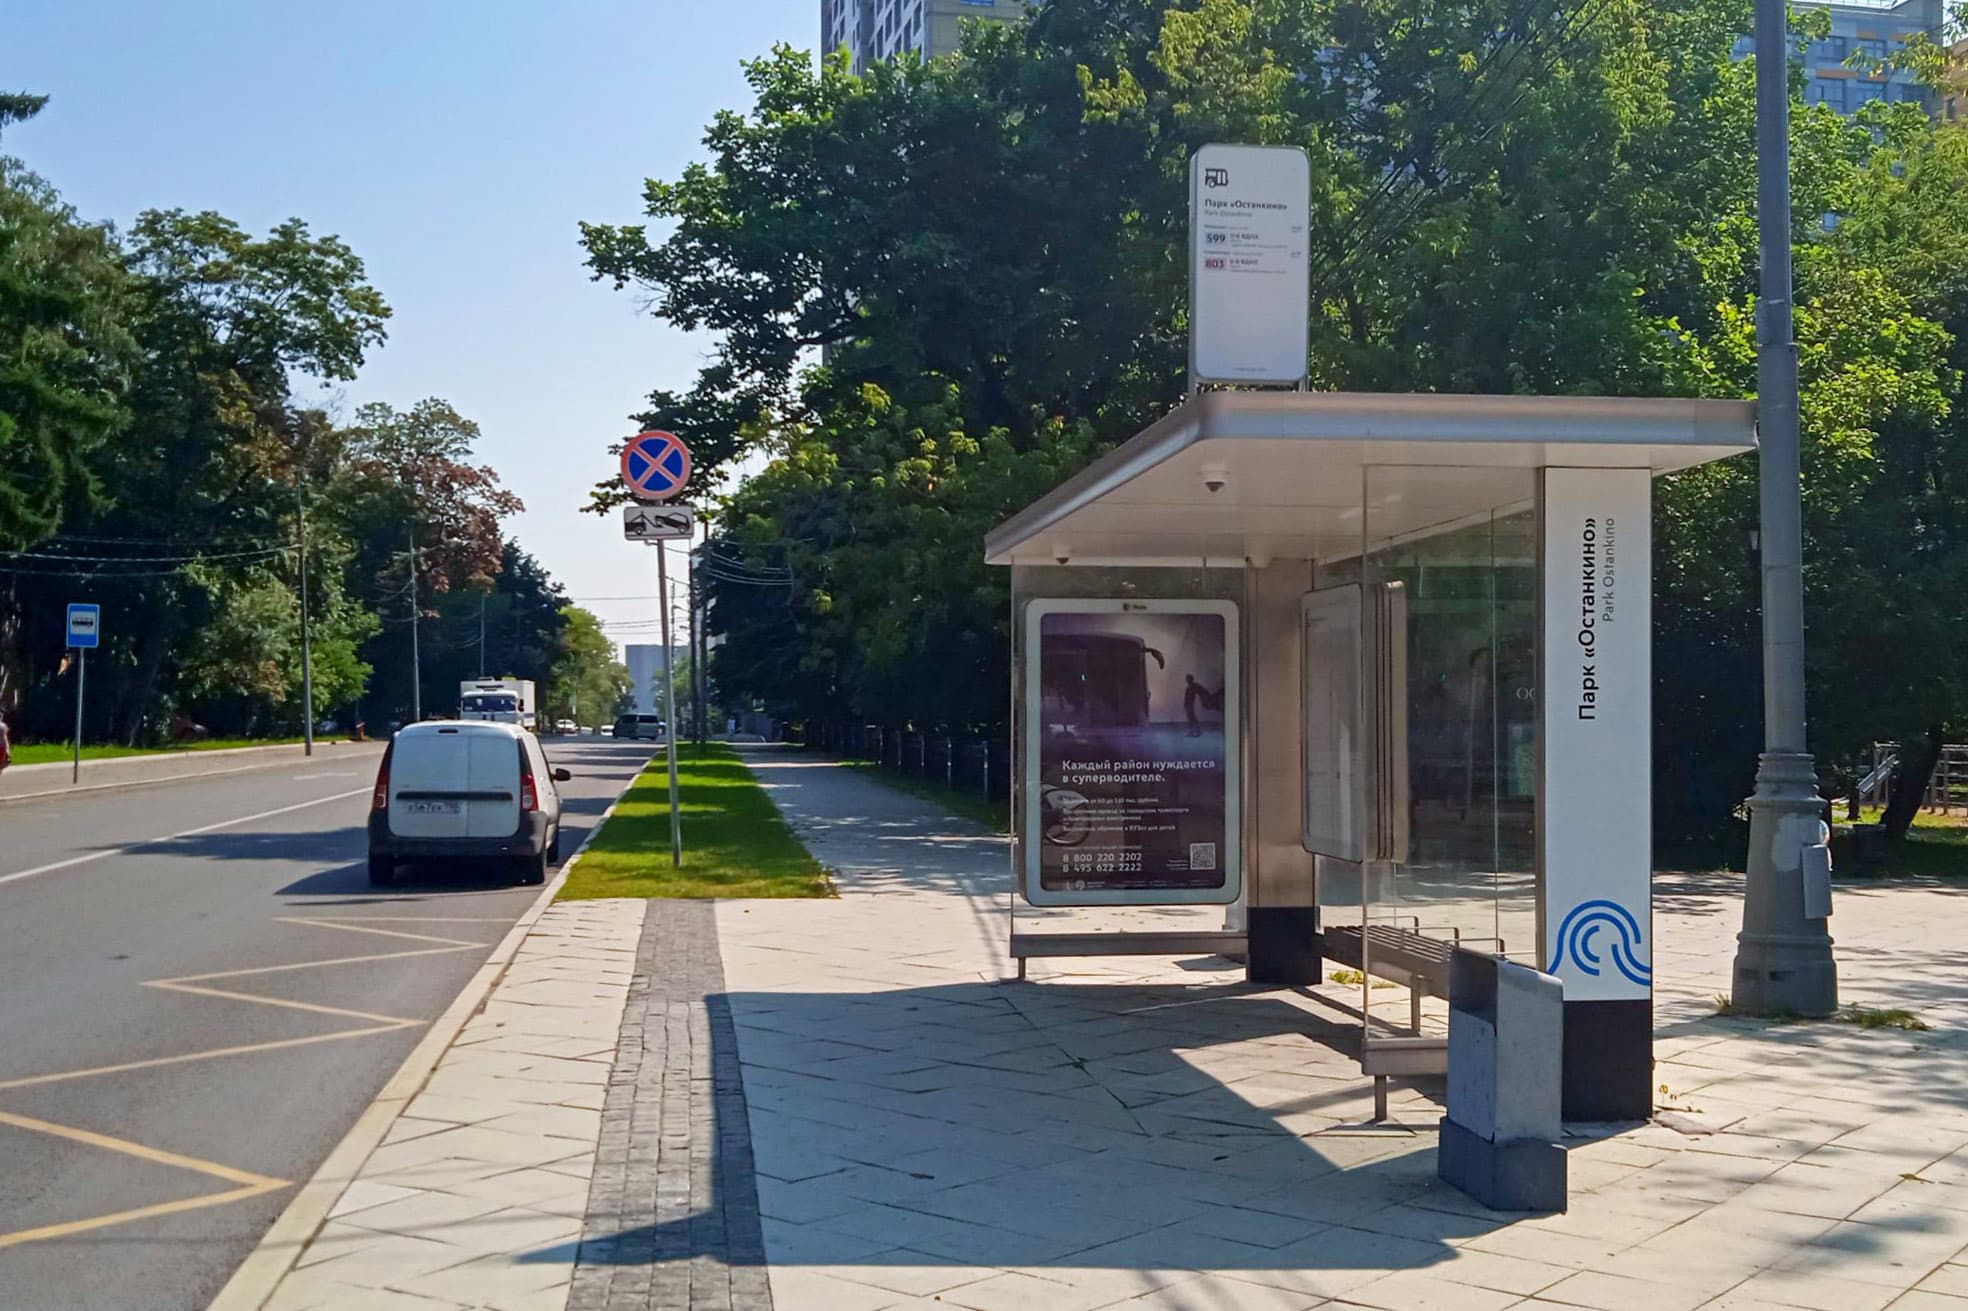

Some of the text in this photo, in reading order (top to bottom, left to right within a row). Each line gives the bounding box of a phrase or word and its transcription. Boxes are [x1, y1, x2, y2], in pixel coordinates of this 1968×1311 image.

[1204, 198, 1288, 210] Парк «Останкино»
[1206, 233, 1226, 243] 599
[1602, 518, 1615, 622] Park Ostankino
[1578, 518, 1599, 720] Парк «Останкино»
[1062, 760, 1216, 772] Каждый район нуждается
[1072, 774, 1166, 785] суперводителе.
[1062, 852, 1142, 863] 8 800 220 2202
[1062, 863, 1142, 873] 8 495 622 2222
